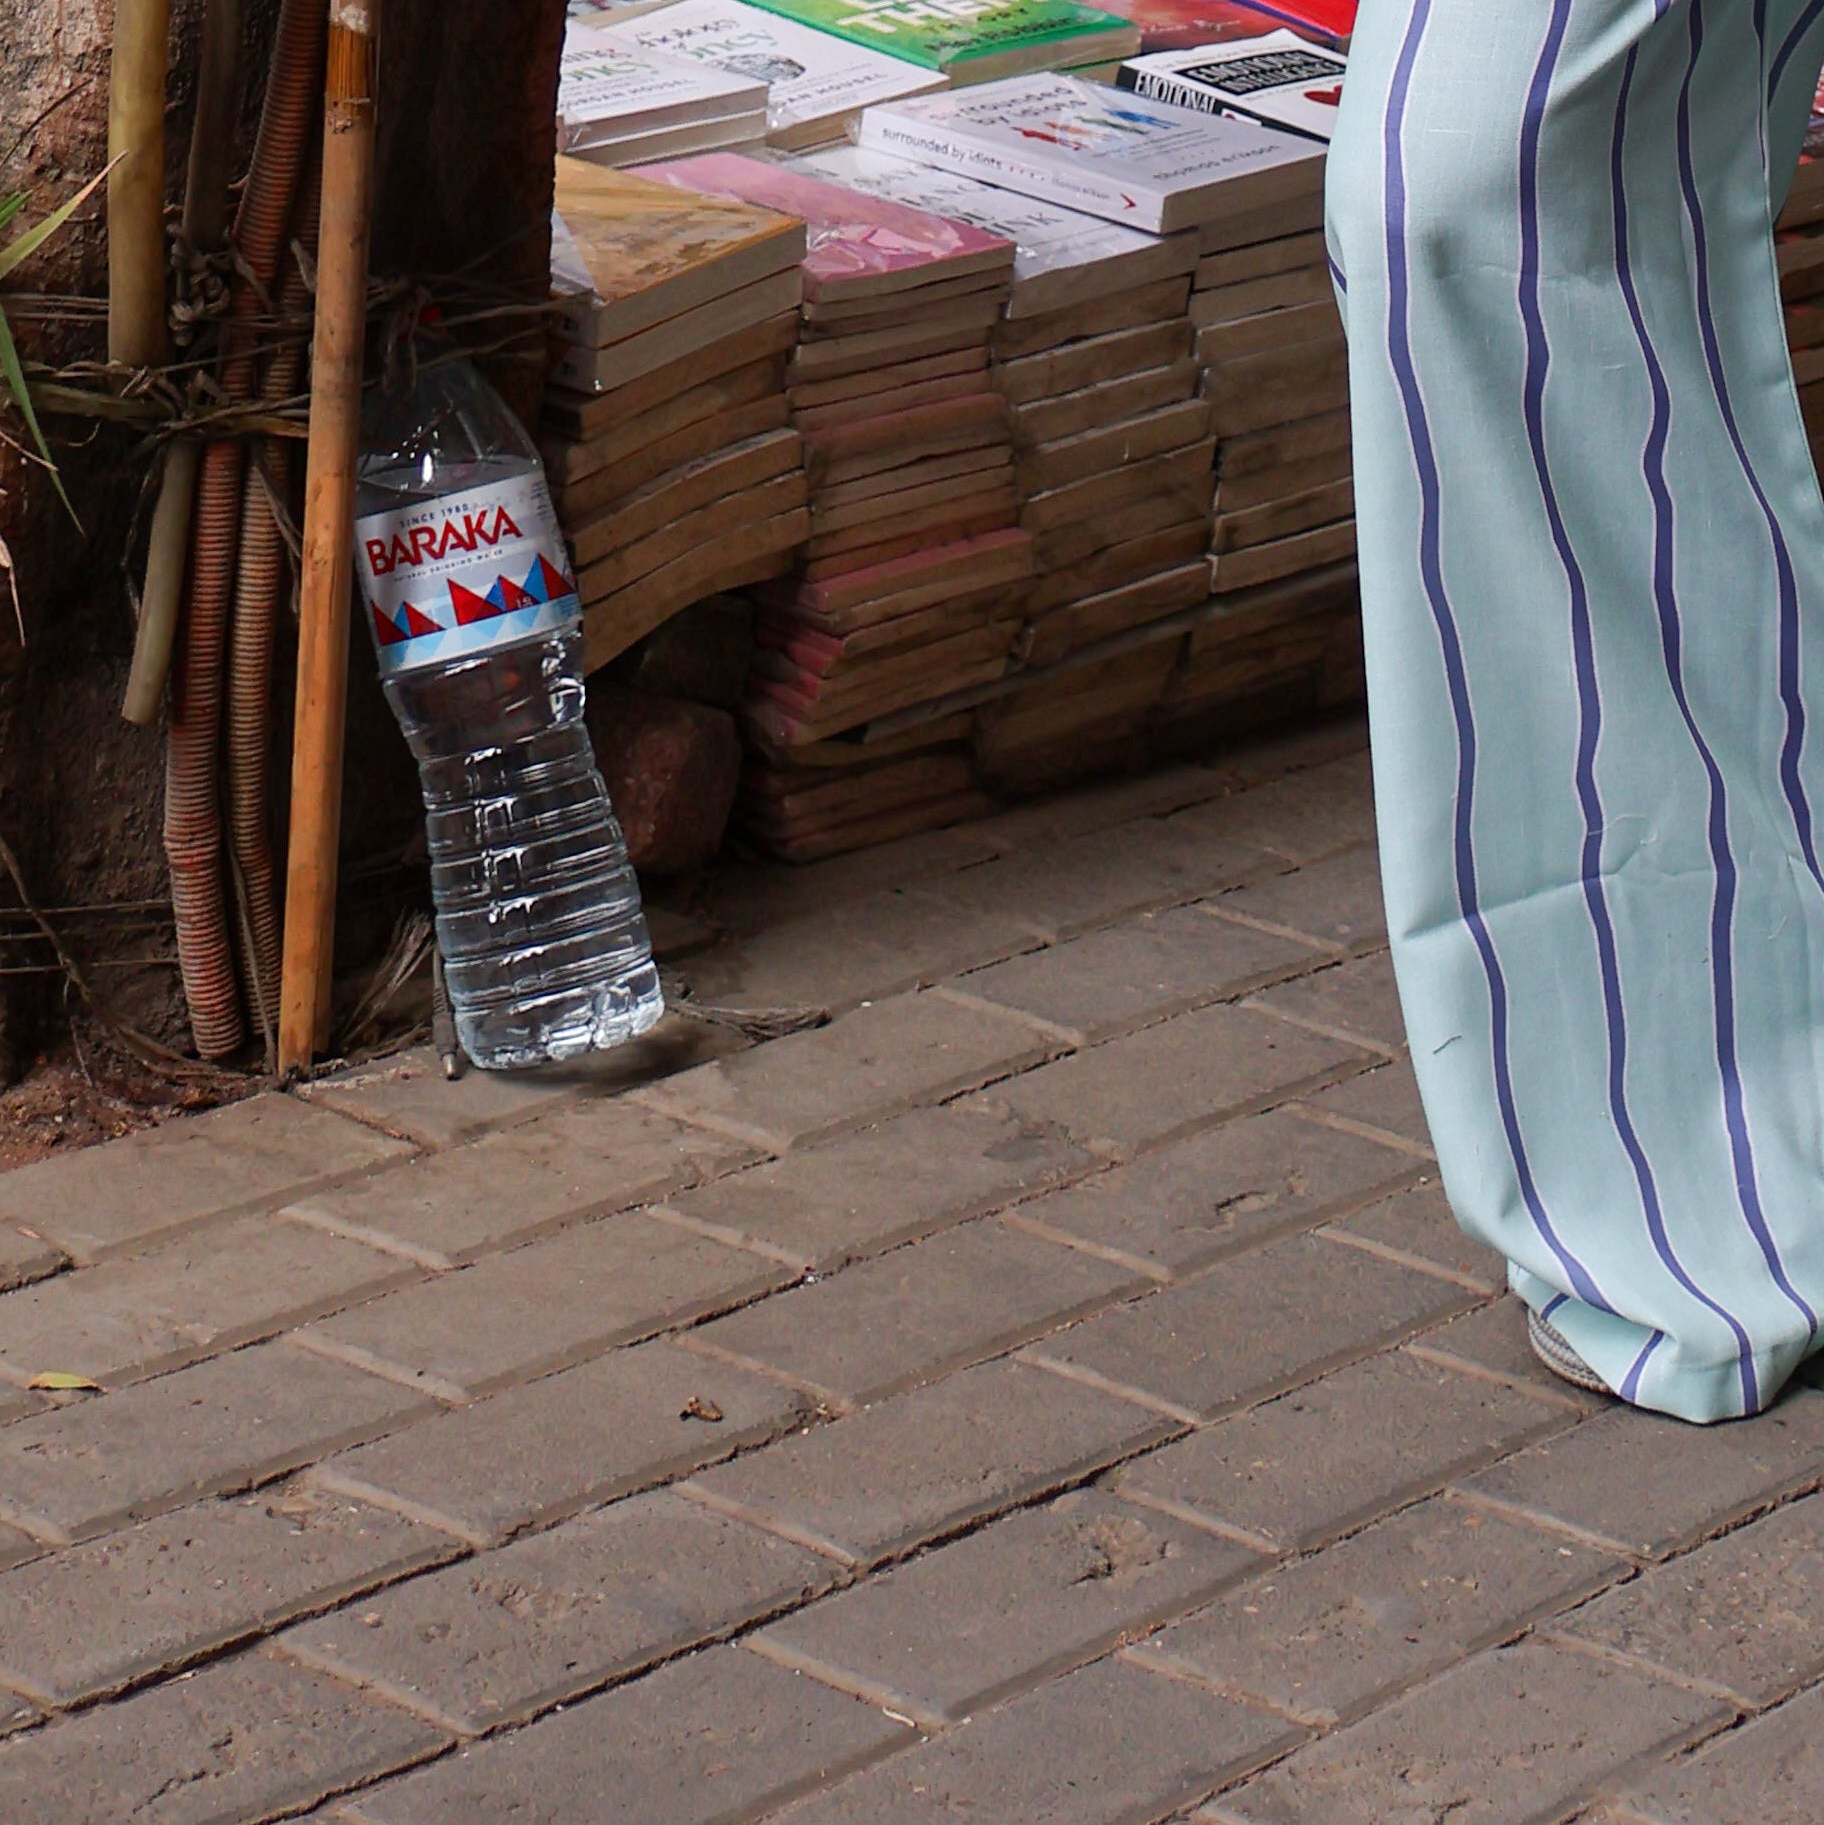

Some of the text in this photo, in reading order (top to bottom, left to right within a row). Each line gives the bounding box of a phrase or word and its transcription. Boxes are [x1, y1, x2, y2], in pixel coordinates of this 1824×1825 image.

[1133, 70, 1217, 115] EMOTIONAL
[882, 126, 950, 156] surrounded
[951, 146, 967, 164] by
[968, 149, 1003, 171] idiots
[400, 503, 470, 529] SINCE 1980
[365, 504, 524, 578] BARAKA
